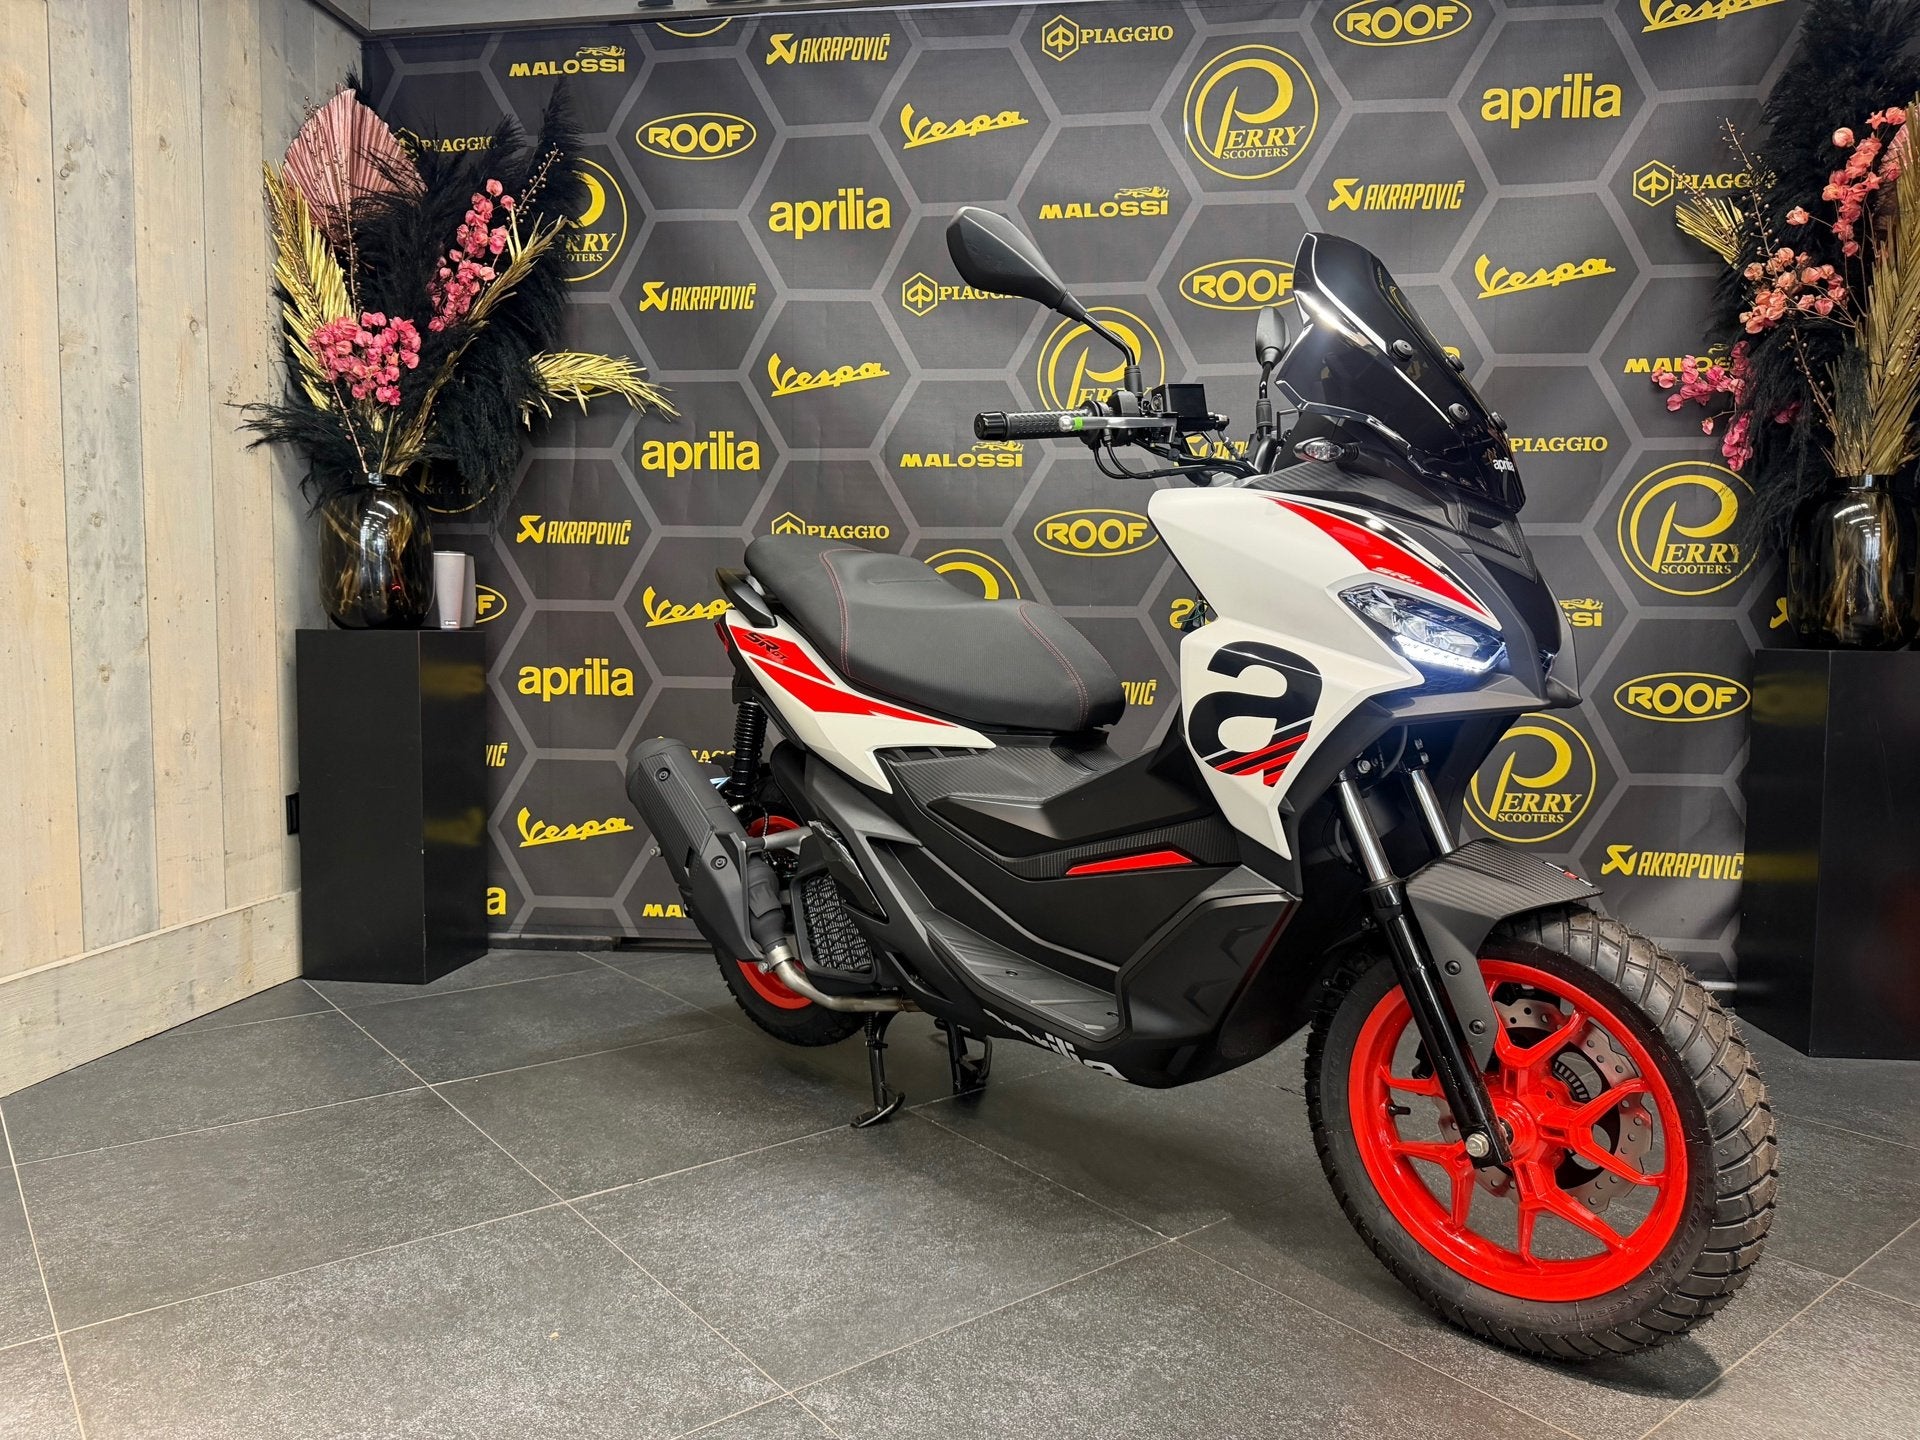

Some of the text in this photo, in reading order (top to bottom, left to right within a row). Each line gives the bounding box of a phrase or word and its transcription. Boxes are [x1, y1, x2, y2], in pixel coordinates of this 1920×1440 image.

[1081, 25, 1174, 45] PIAGGIO
[1347, 4, 1459, 39] ROOF
[509, 59, 625, 77] MALOSSI
[1195, 58, 1306, 159] PERRY
[1480, 72, 1622, 129] aprilia
[648, 122, 744, 154] ROOF
[899, 104, 1029, 150] Vespa
[1222, 146, 1289, 160] SCOOTERS
[768, 187, 892, 241] aprilia
[1038, 199, 1169, 220] MALOSSI
[1193, 269, 1293, 303] ROOF
[1475, 256, 1616, 300] Vespa
[768, 353, 889, 398] Vespa
[641, 431, 760, 478] aprilia
[900, 453, 1023, 469] MALOSSI
[1509, 436, 1609, 454] PIAGGIO
[806, 525, 890, 541] PIAGGIO
[1046, 515, 1147, 550] ROOF
[1660, 563, 1732, 575] SCOOTERS
[643, 586, 735, 627] Vesp
[744, 632, 780, 652] SR
[518, 658, 634, 702] aprilia
[1628, 682, 1737, 715] ROOF
[1476, 725, 1583, 821] PERRY
[517, 807, 634, 848] Vespa
[1497, 812, 1565, 824] SCOOTERS
